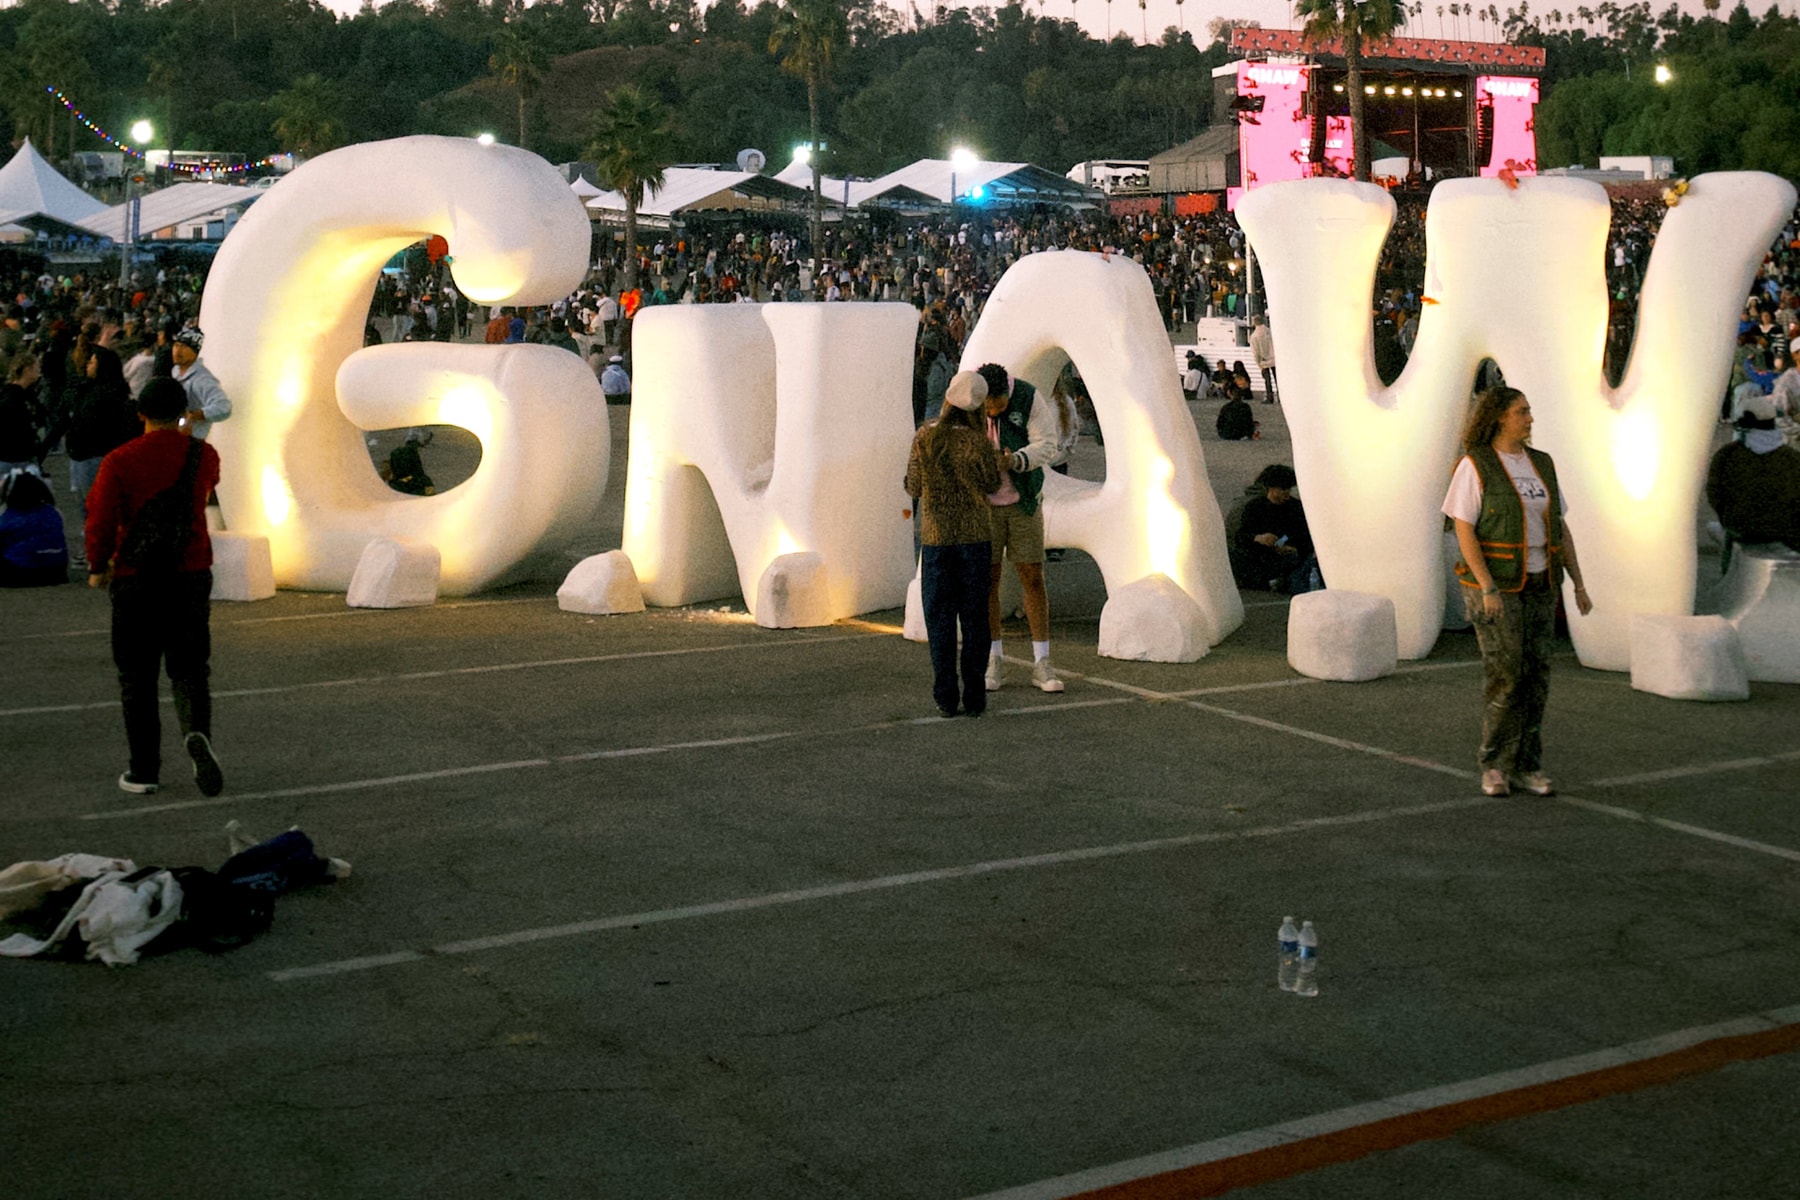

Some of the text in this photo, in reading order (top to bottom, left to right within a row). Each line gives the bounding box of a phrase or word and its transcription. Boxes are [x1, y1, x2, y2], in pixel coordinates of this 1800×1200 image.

[1247, 67, 1299, 85] GNAW
[1484, 80, 1531, 98] GNAW
[201, 134, 1798, 673] GNAW
